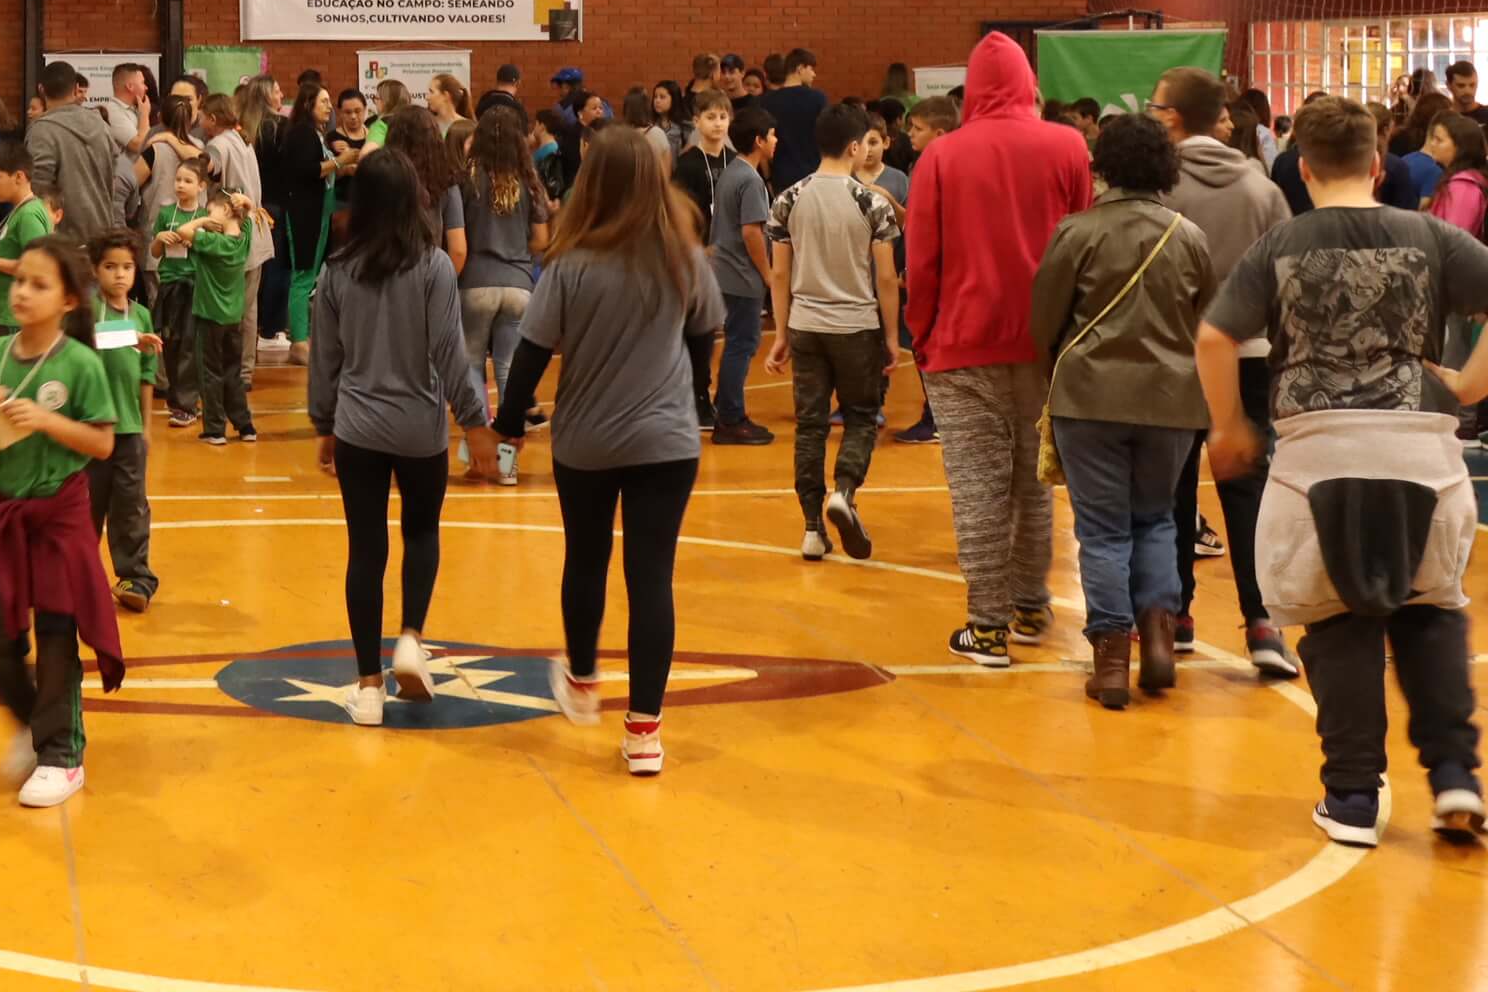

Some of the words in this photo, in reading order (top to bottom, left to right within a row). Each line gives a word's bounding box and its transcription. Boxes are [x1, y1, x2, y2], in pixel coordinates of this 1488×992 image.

[376, 0, 395, 8] NO
[397, 0, 445, 8] CAMPO:
[447, 0, 515, 8] SEMEANDO
[447, 14, 506, 23] VALORES!
